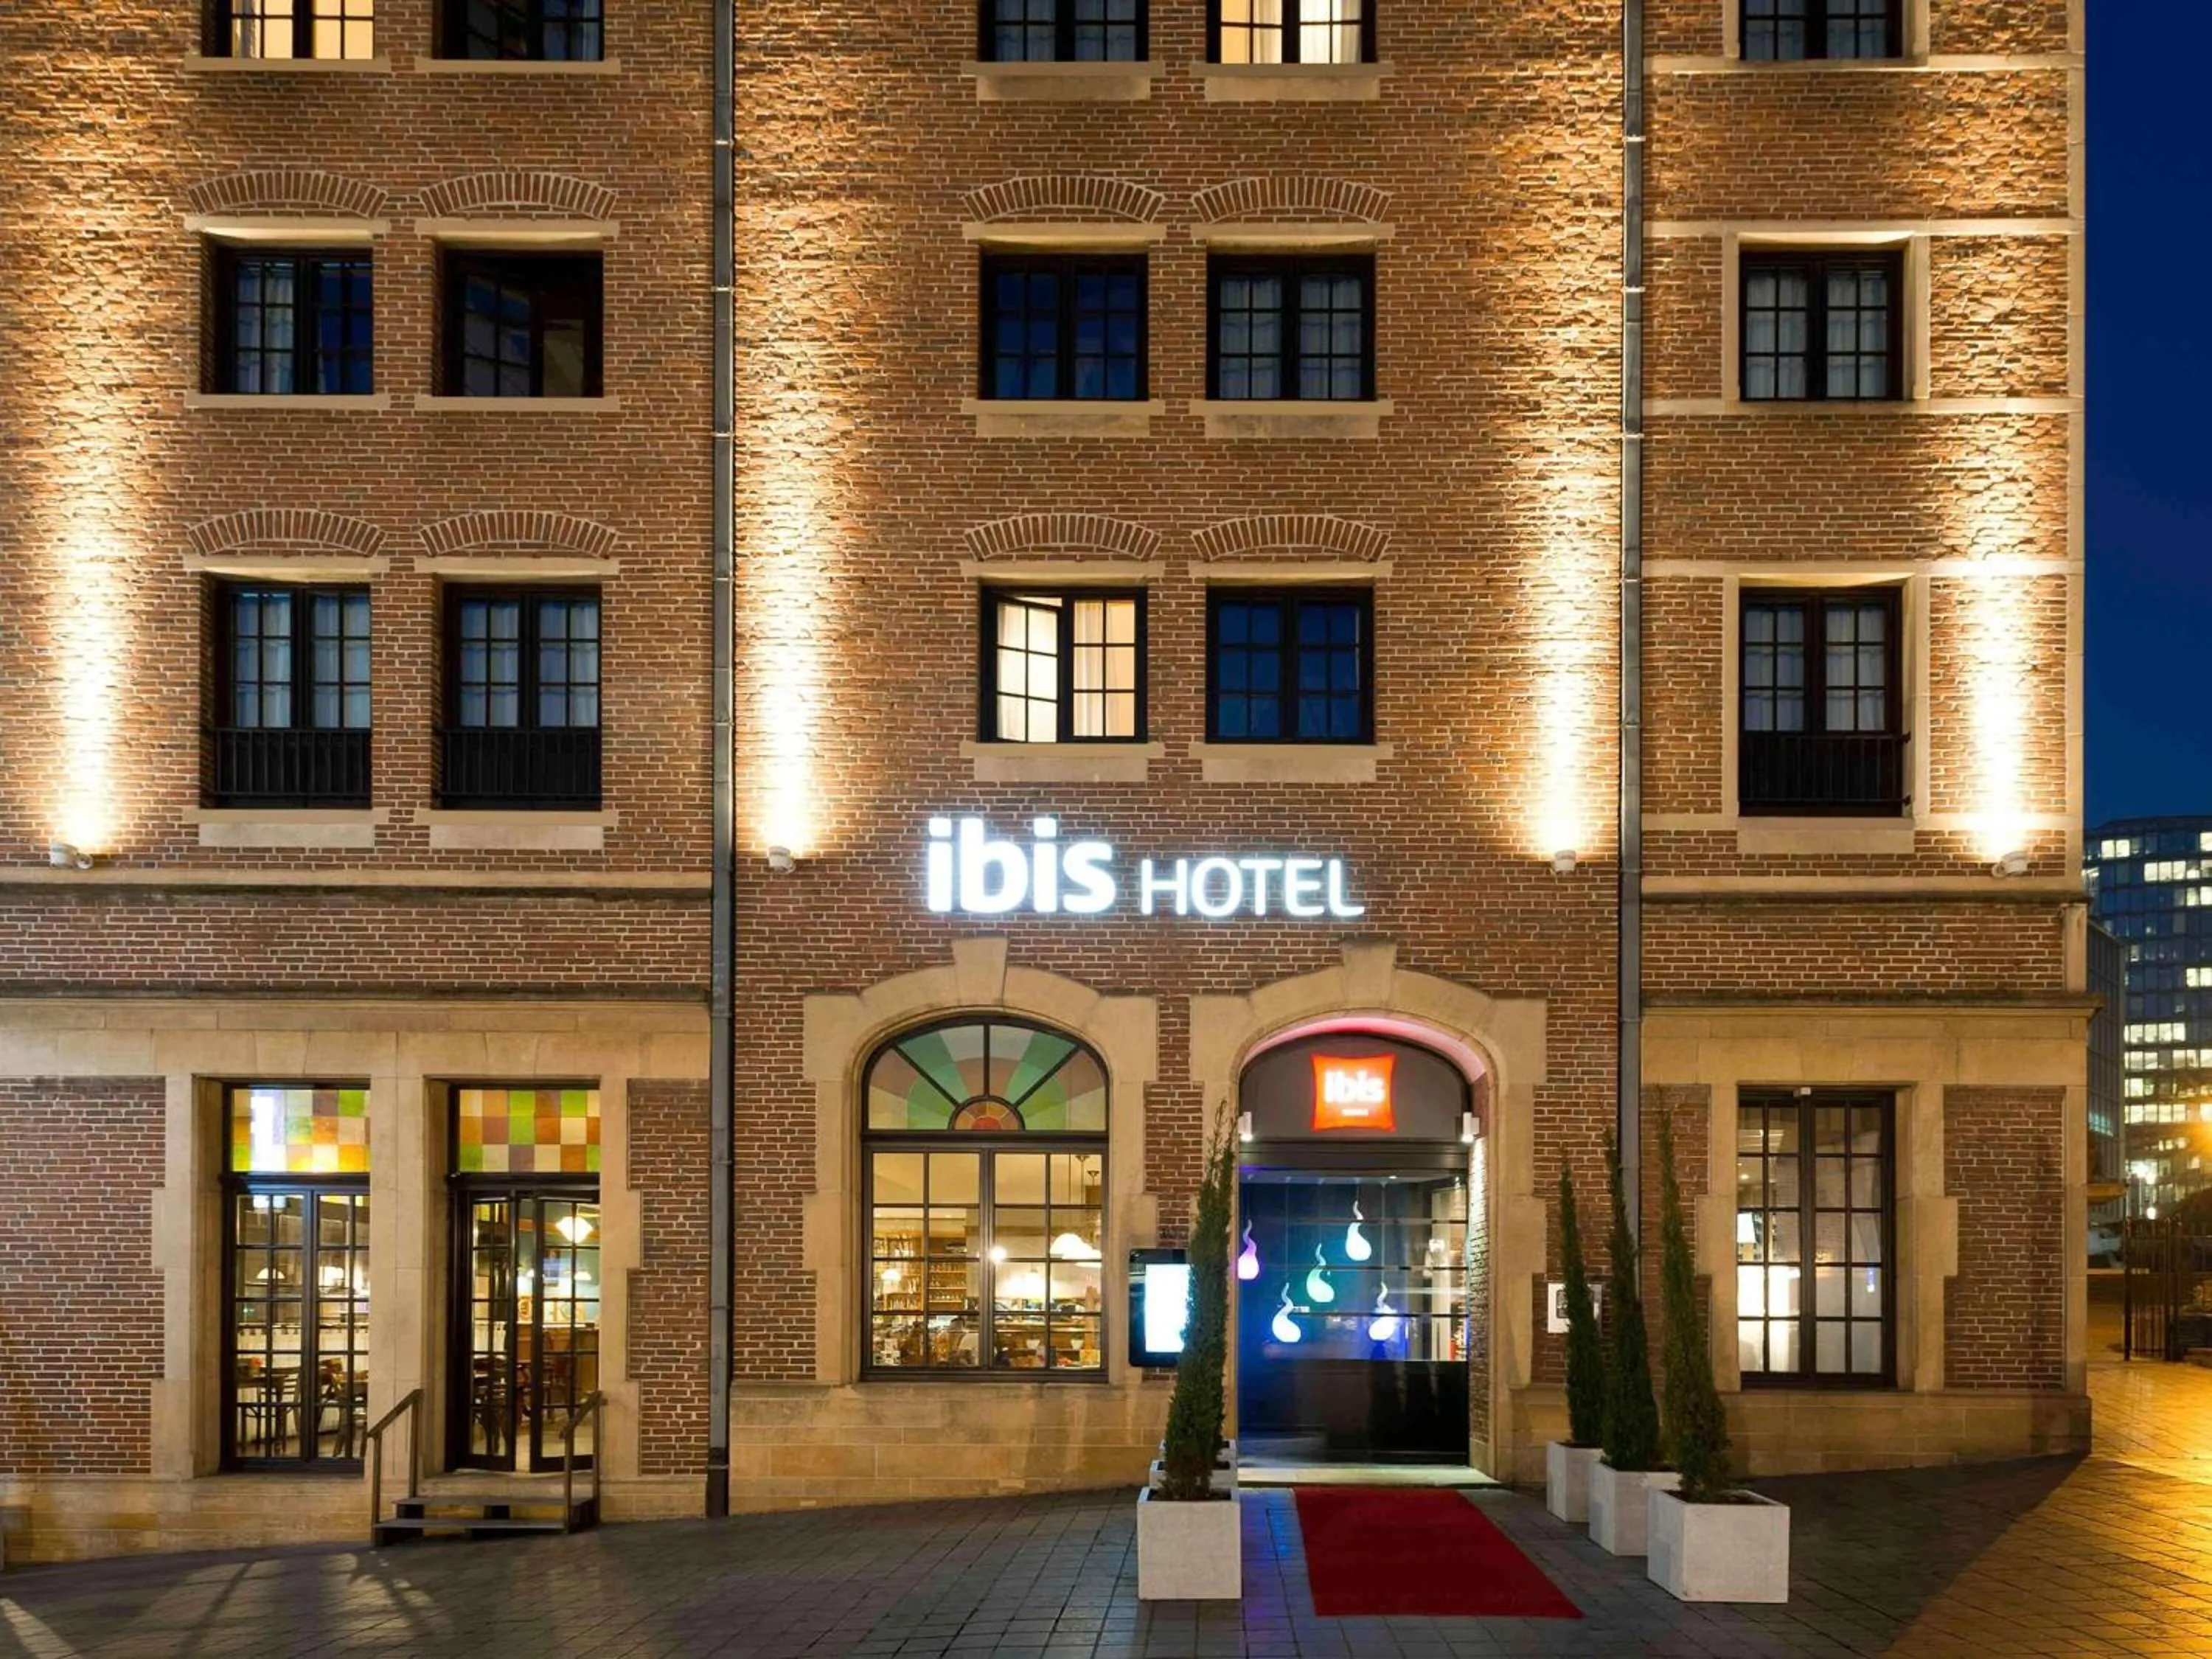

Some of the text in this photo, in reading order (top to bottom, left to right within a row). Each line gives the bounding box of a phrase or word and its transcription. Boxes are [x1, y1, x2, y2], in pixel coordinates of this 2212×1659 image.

[928, 817, 1366, 917] ibis HOTEL
[1324, 1070, 1384, 1103] ibis
